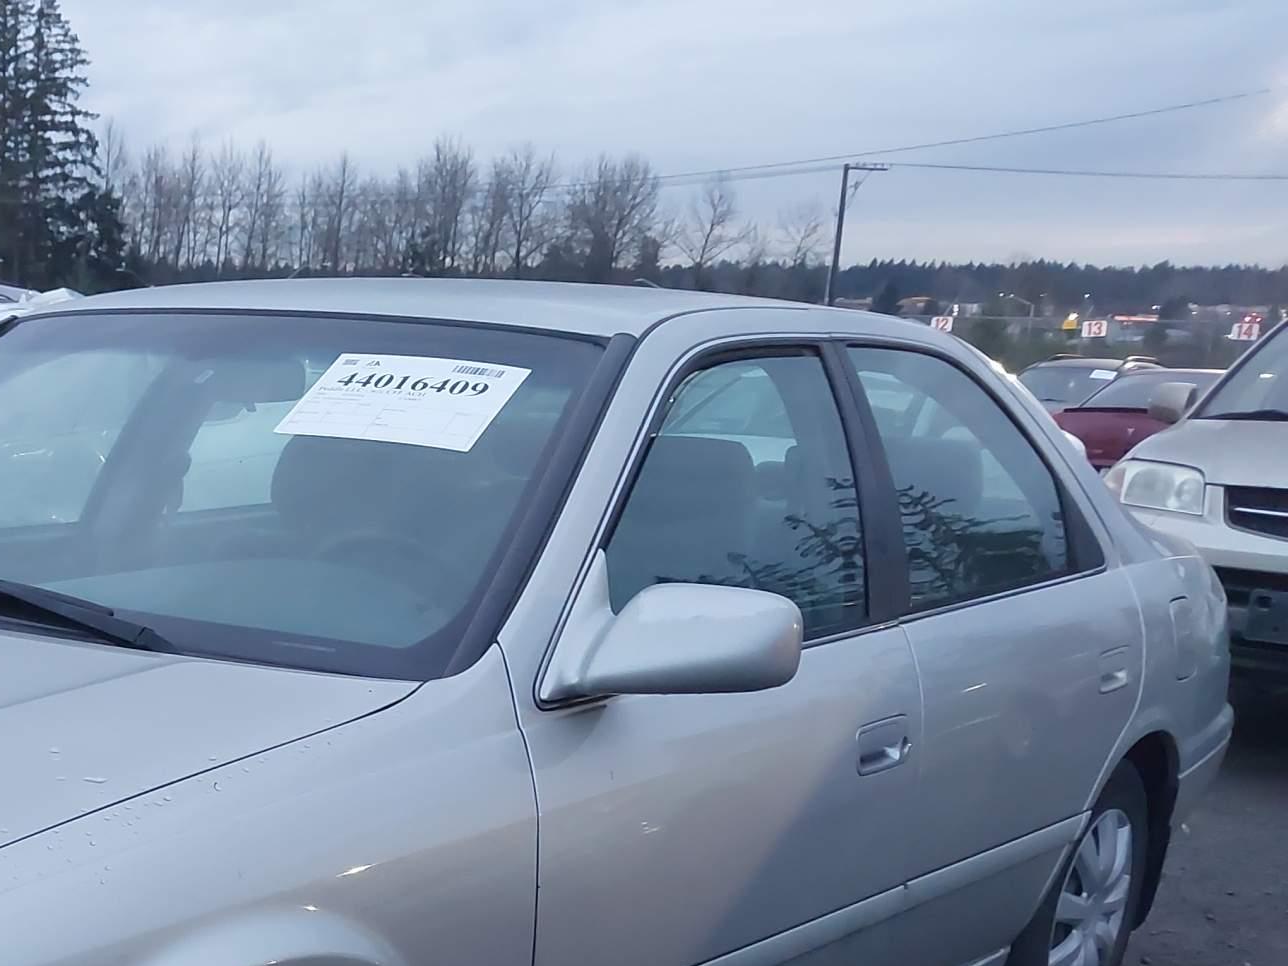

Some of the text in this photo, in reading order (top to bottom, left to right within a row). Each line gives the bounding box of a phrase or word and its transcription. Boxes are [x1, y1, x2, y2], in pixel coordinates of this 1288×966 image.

[935, 318, 949, 331] 12
[1088, 322, 1103, 336] 13
[1237, 323, 1255, 339] 14
[337, 371, 489, 397] 44016409
